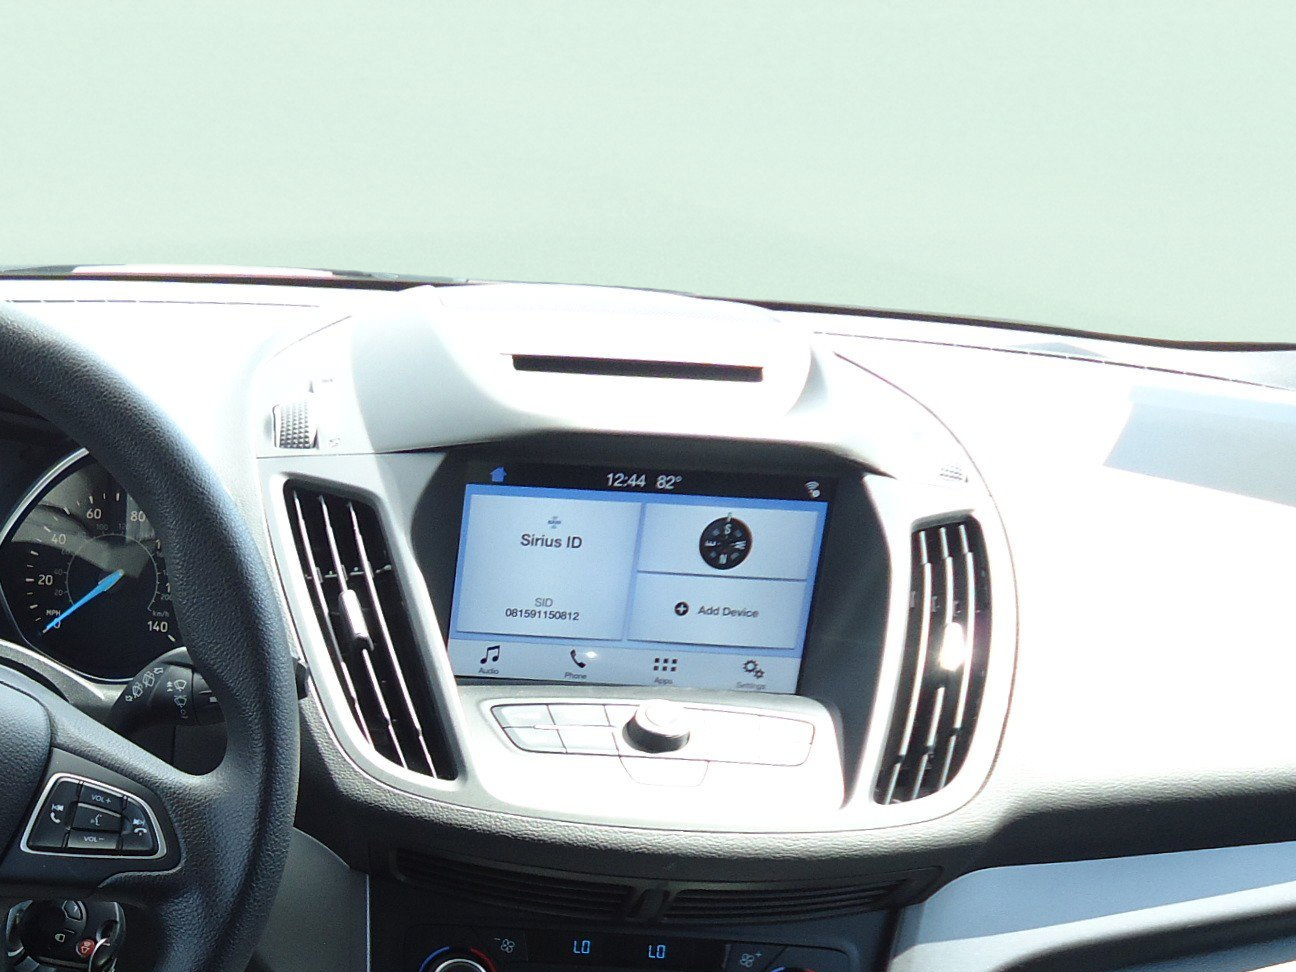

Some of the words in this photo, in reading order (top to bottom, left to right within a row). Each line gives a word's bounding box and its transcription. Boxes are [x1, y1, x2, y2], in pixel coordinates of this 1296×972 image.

[606, 473, 646, 488] 12:44
[86, 508, 102, 520] 60
[130, 510, 146, 523] 80
[51, 533, 66, 545] 40
[520, 532, 562, 548] Sirius
[566, 535, 583, 549] ID
[38, 574, 53, 586] 20
[534, 598, 553, 608] SID
[505, 608, 580, 622] 081591150812
[698, 605, 719, 617] Add
[721, 607, 759, 620] Device
[147, 620, 168, 633] 140
[478, 667, 499, 675] Audio
[564, 671, 587, 681] Phone
[654, 676, 673, 686] Apps
